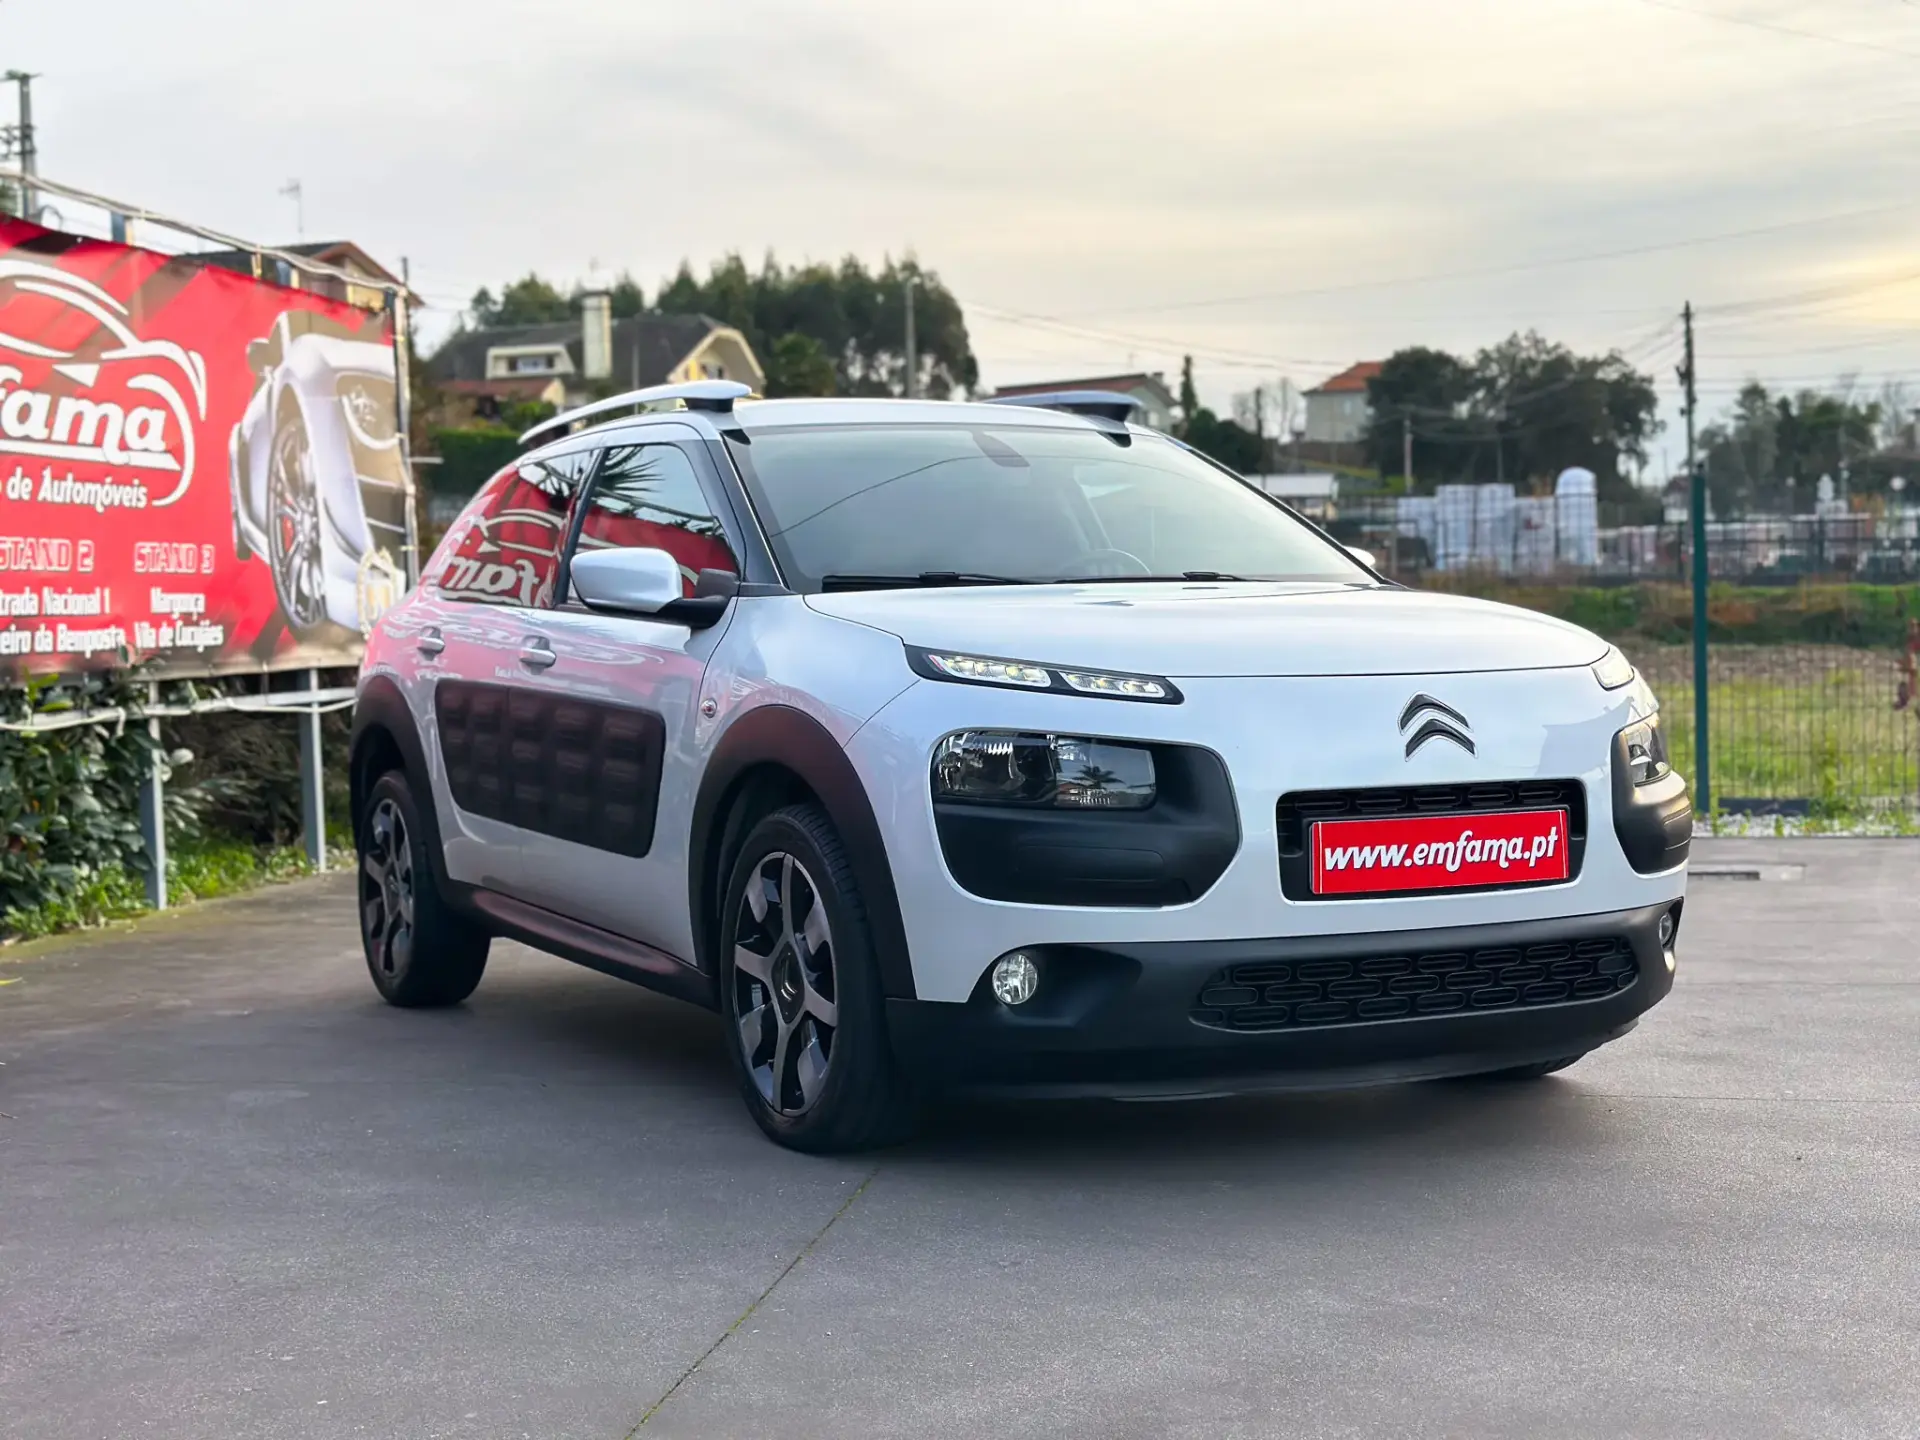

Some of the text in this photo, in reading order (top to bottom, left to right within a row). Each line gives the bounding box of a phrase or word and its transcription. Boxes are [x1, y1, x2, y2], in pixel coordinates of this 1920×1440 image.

[6, 465, 148, 513] de Automóveis
[0, 536, 95, 573] STAND 2
[133, 541, 215, 575] STAND 3
[42, 586, 101, 616] Nacional
[34, 623, 54, 653] da
[158, 621, 174, 648] de
[1324, 826, 1558, 872] www.emfama.pt
